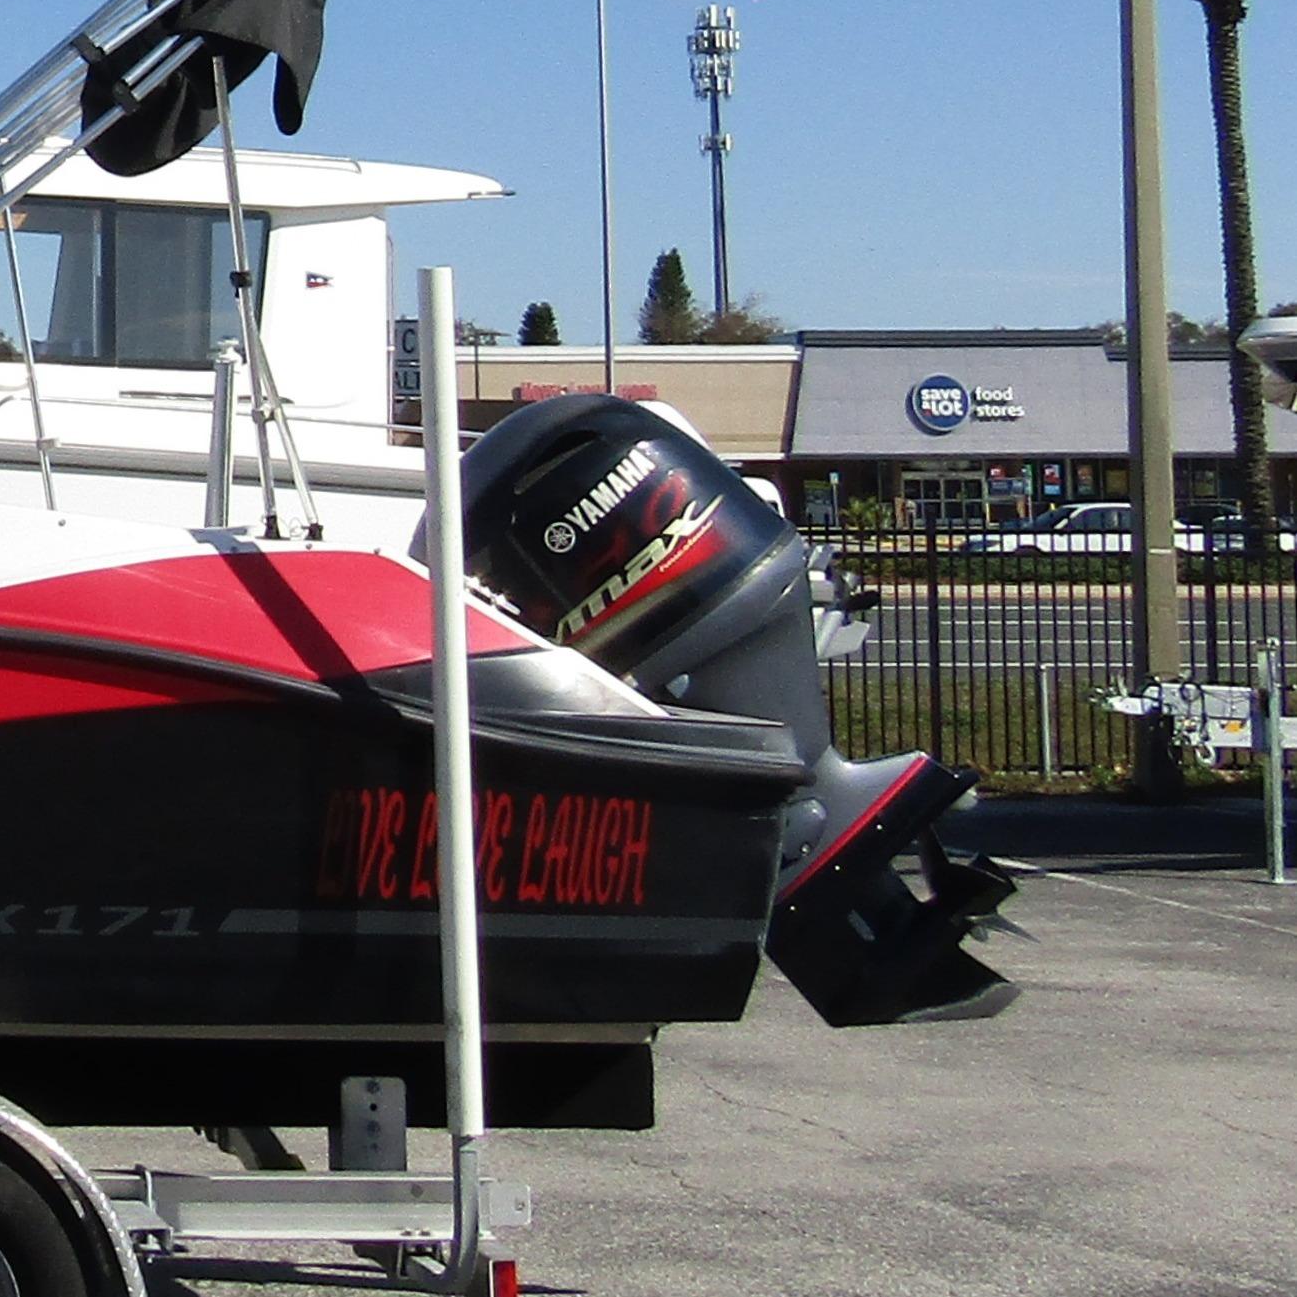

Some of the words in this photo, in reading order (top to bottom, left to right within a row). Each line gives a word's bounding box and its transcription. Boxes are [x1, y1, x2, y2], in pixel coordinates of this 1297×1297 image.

[920, 388, 962, 401] save
[974, 386, 1014, 401] food
[976, 404, 1026, 417] stores
[564, 448, 657, 533] YAMAHA
[517, 793, 652, 906] LAUGH
